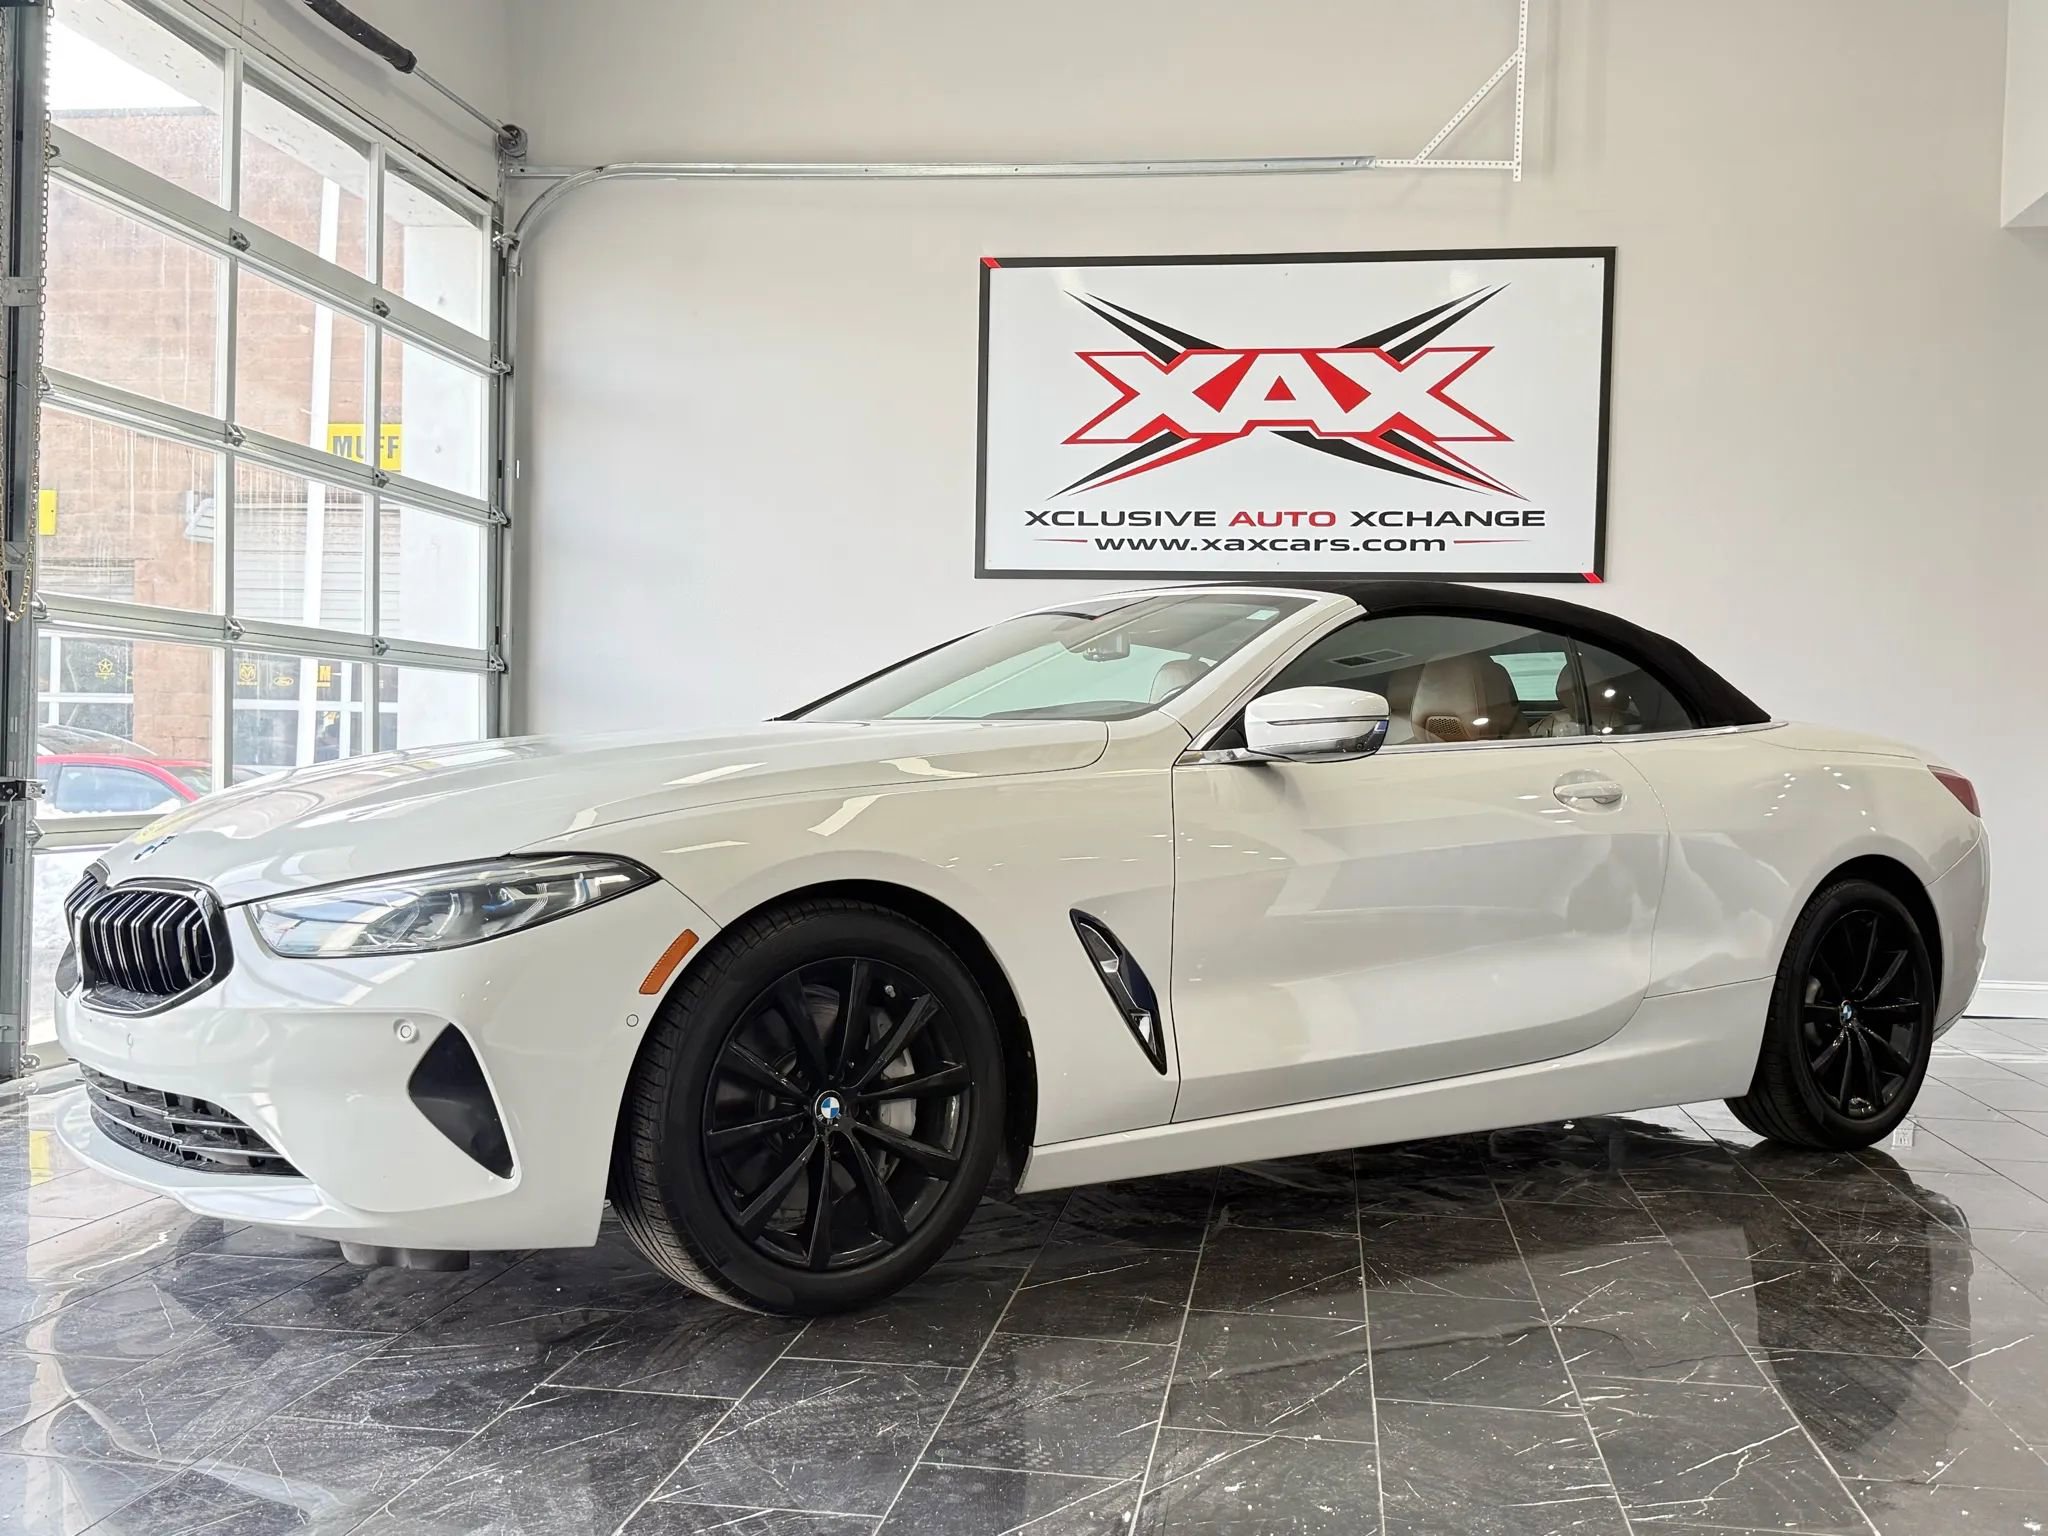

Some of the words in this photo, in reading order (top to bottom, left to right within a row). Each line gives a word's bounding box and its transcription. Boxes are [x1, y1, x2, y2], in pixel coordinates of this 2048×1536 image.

[1060, 346, 1515, 445] XAX
[1024, 510, 1217, 527] XCLUSIVE
[1228, 511, 1336, 528] AUTO
[1349, 510, 1546, 527] XCHANGE
[1094, 538, 1446, 552] www.xaxcars.com
